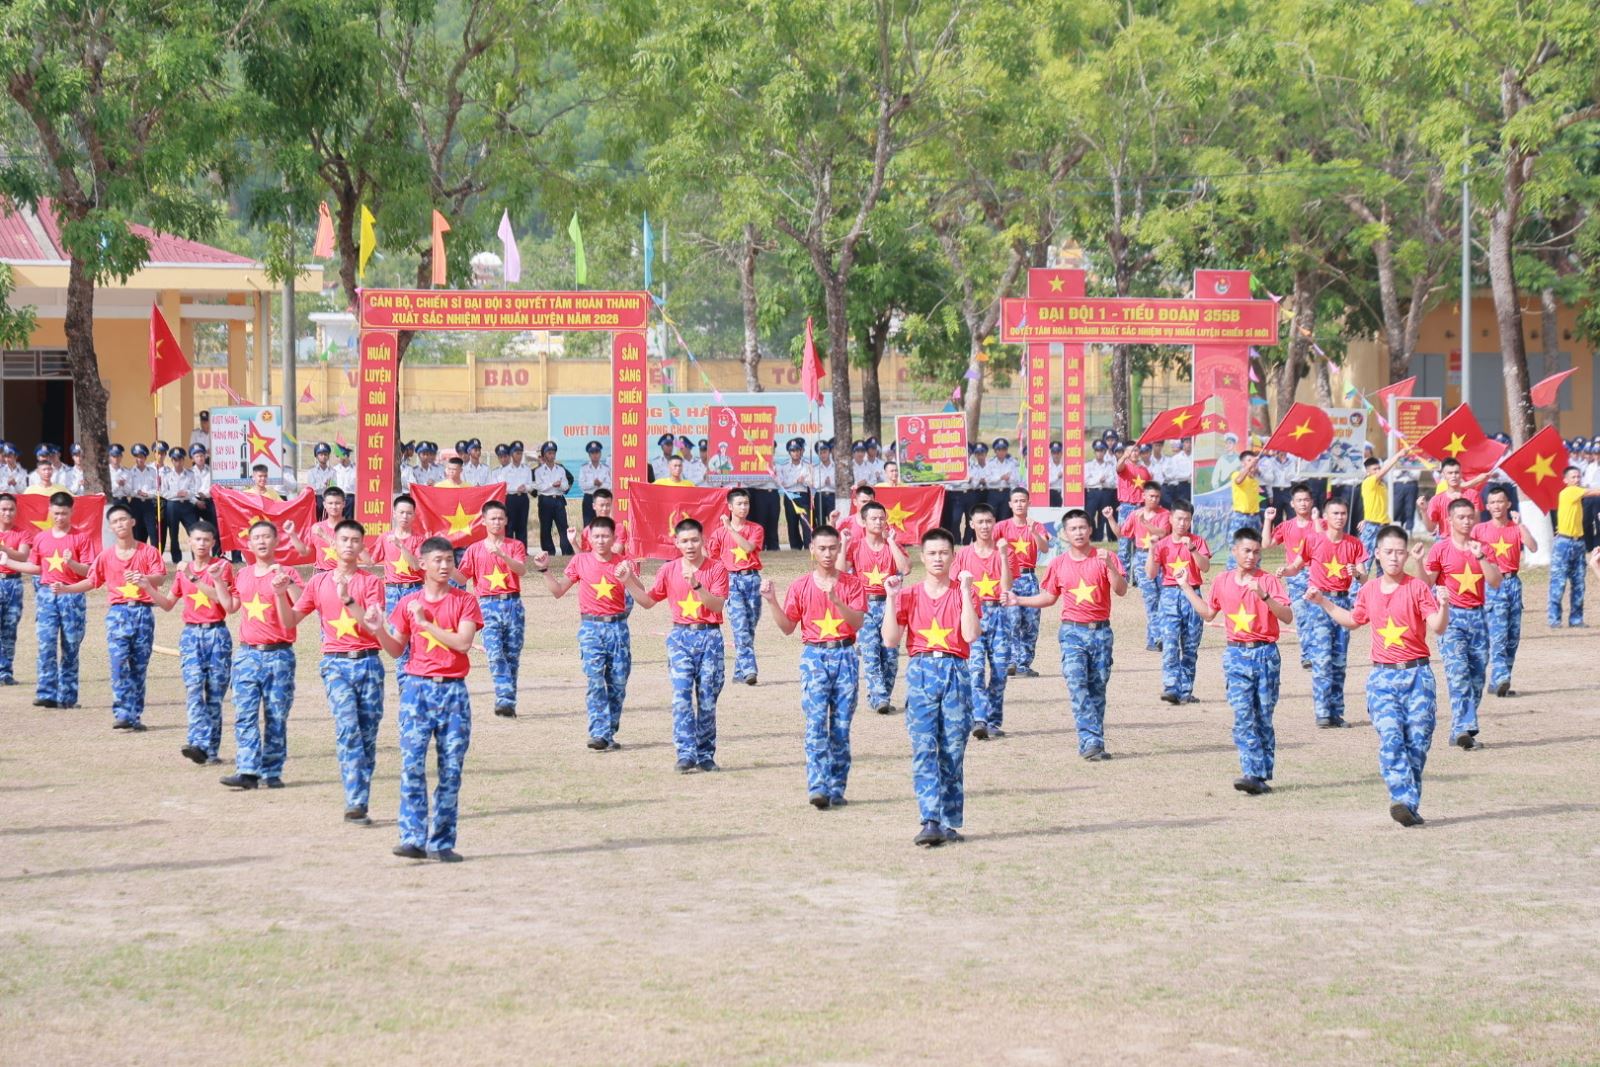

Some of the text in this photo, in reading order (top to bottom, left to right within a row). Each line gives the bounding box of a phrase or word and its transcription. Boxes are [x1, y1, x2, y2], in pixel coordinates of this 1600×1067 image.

[370, 294, 640, 311] CÁN BỘ, CHIẾN SĨ ĐẠI ĐỘI 3 QUYẾT TÂM HOÀN THÀNH
[392, 309, 619, 327] XUẤT SẮC NHIỆM VỤ HUẤN LUYỆN NĂM 2026
[1039, 307, 1064, 322] ĐẠI
[1069, 304, 1094, 321] ĐỘI
[1099, 307, 1106, 320] 1
[1159, 306, 1200, 321] ĐOÀN
[1204, 309, 1240, 322] 355B
[1053, 325, 1073, 336] HOÀN
[1075, 326, 1099, 336] THÀNH
[1101, 324, 1120, 336] XUẤT
[1138, 326, 1162, 337] NHIỆM
[1197, 327, 1220, 338] LUYỆN
[1222, 327, 1243, 337] CHIẾN
[367, 342, 391, 360] HUẤN
[365, 366, 391, 386] LUYỆN
[619, 366, 641, 382] SÀNG
[369, 386, 386, 404] GIỎI
[618, 386, 642, 404] CHIẾN
[364, 410, 389, 427] ĐOÀN
[621, 408, 638, 425] ĐẤU
[1031, 410, 1046, 424] ĐỘNG
[368, 431, 384, 448] KẾT
[622, 433, 638, 447] CAO
[1031, 427, 1046, 440] ĐOÀN
[1034, 444, 1043, 457] KẾT
[368, 454, 383, 470] TỐT
[624, 455, 636, 468] AN
[368, 475, 381, 492] KỶ
[364, 499, 384, 517] LUẬT
